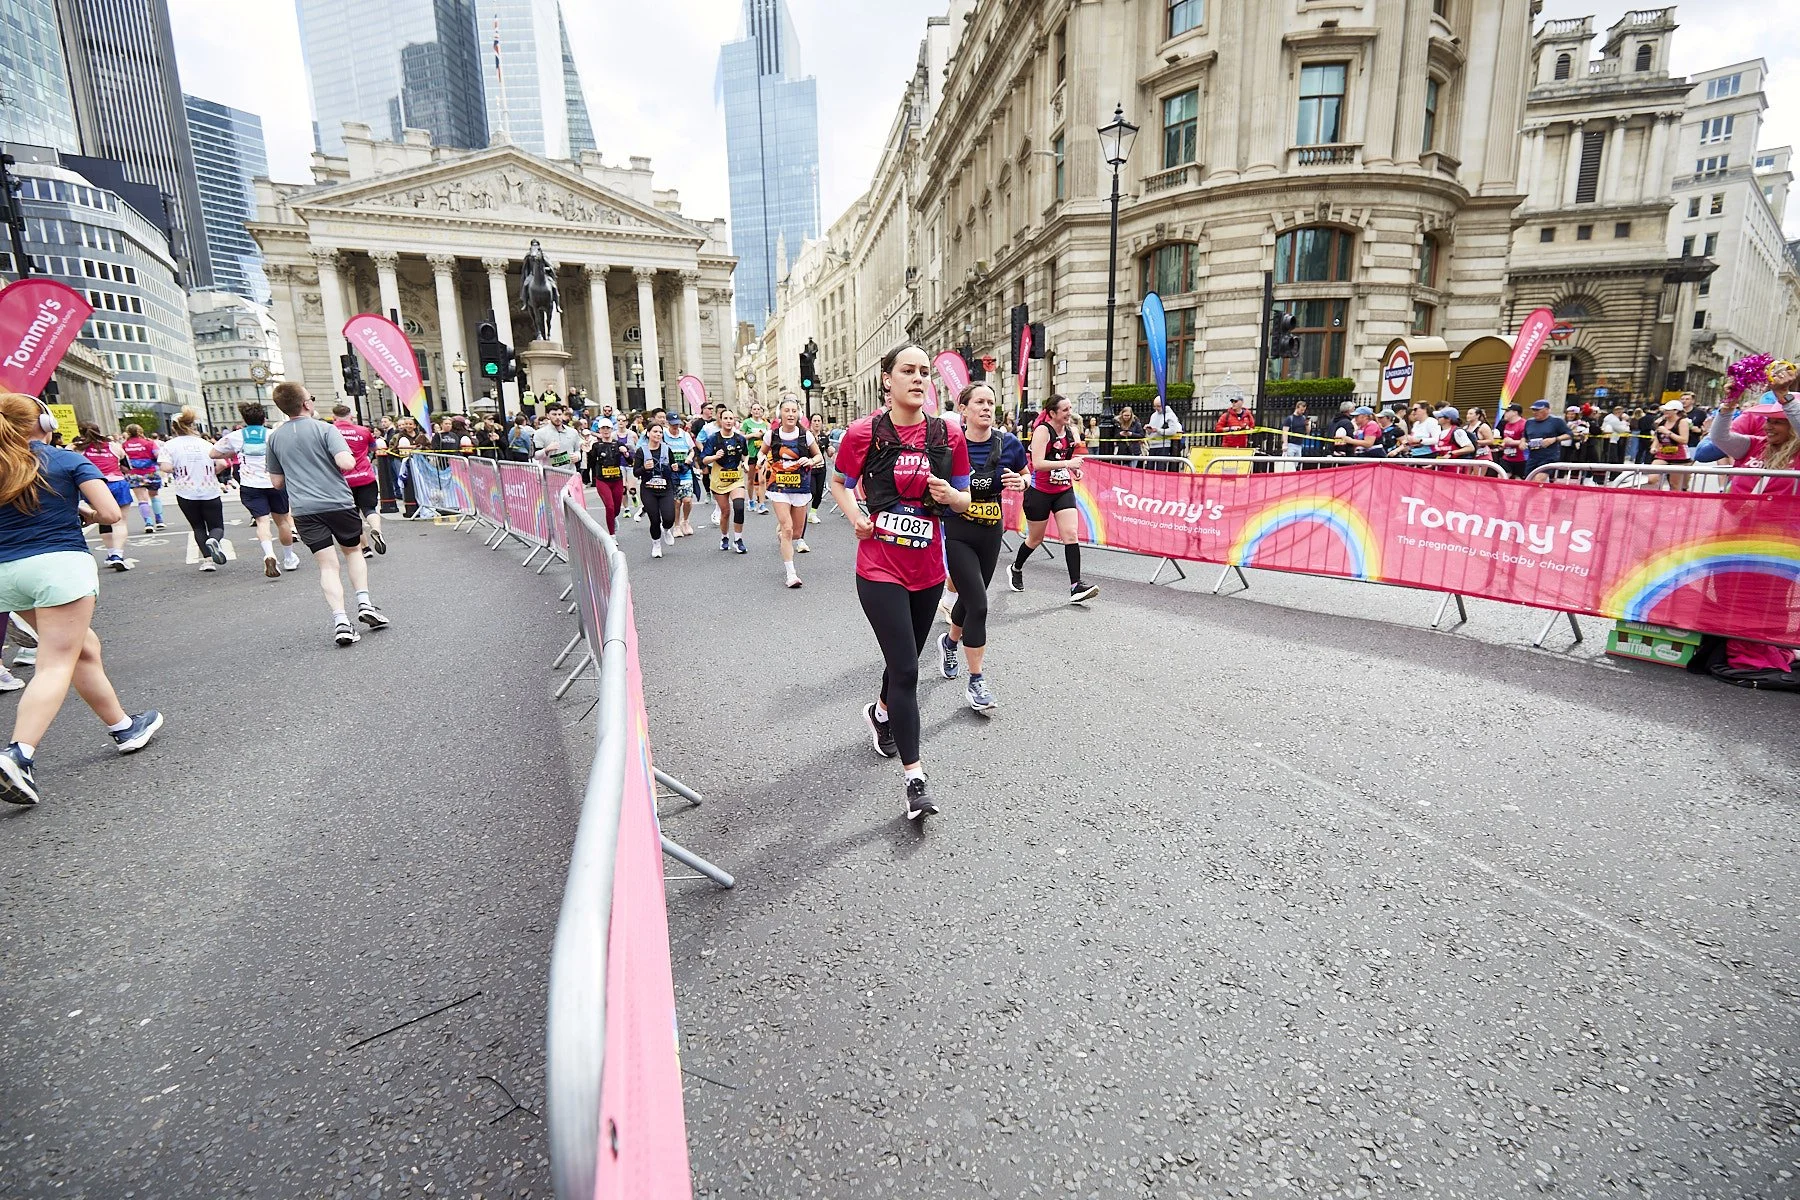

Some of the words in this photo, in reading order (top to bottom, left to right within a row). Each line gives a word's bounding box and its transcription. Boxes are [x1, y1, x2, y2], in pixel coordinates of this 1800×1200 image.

[3, 299, 62, 369] Tommy's
[1511, 321, 1544, 374] Tommy's
[28, 367, 39, 377] The
[38, 345, 54, 369] pregnancy
[1386, 366, 1412, 379] UNDERGROUND
[1112, 486, 1225, 524] Tommy's
[882, 514, 930, 536] 11087
[1111, 513, 1122, 521] The
[1122, 514, 1158, 529] pregnancy
[1159, 521, 1173, 530] and
[1174, 523, 1193, 535] baby
[1193, 525, 1221, 537] charity
[1401, 496, 1594, 555] Tommy's
[1397, 535, 1416, 546] The
[1418, 538, 1477, 557] pregnancy
[1479, 549, 1499, 560] and
[1502, 552, 1536, 569] baby
[1539, 559, 1589, 577] charity
